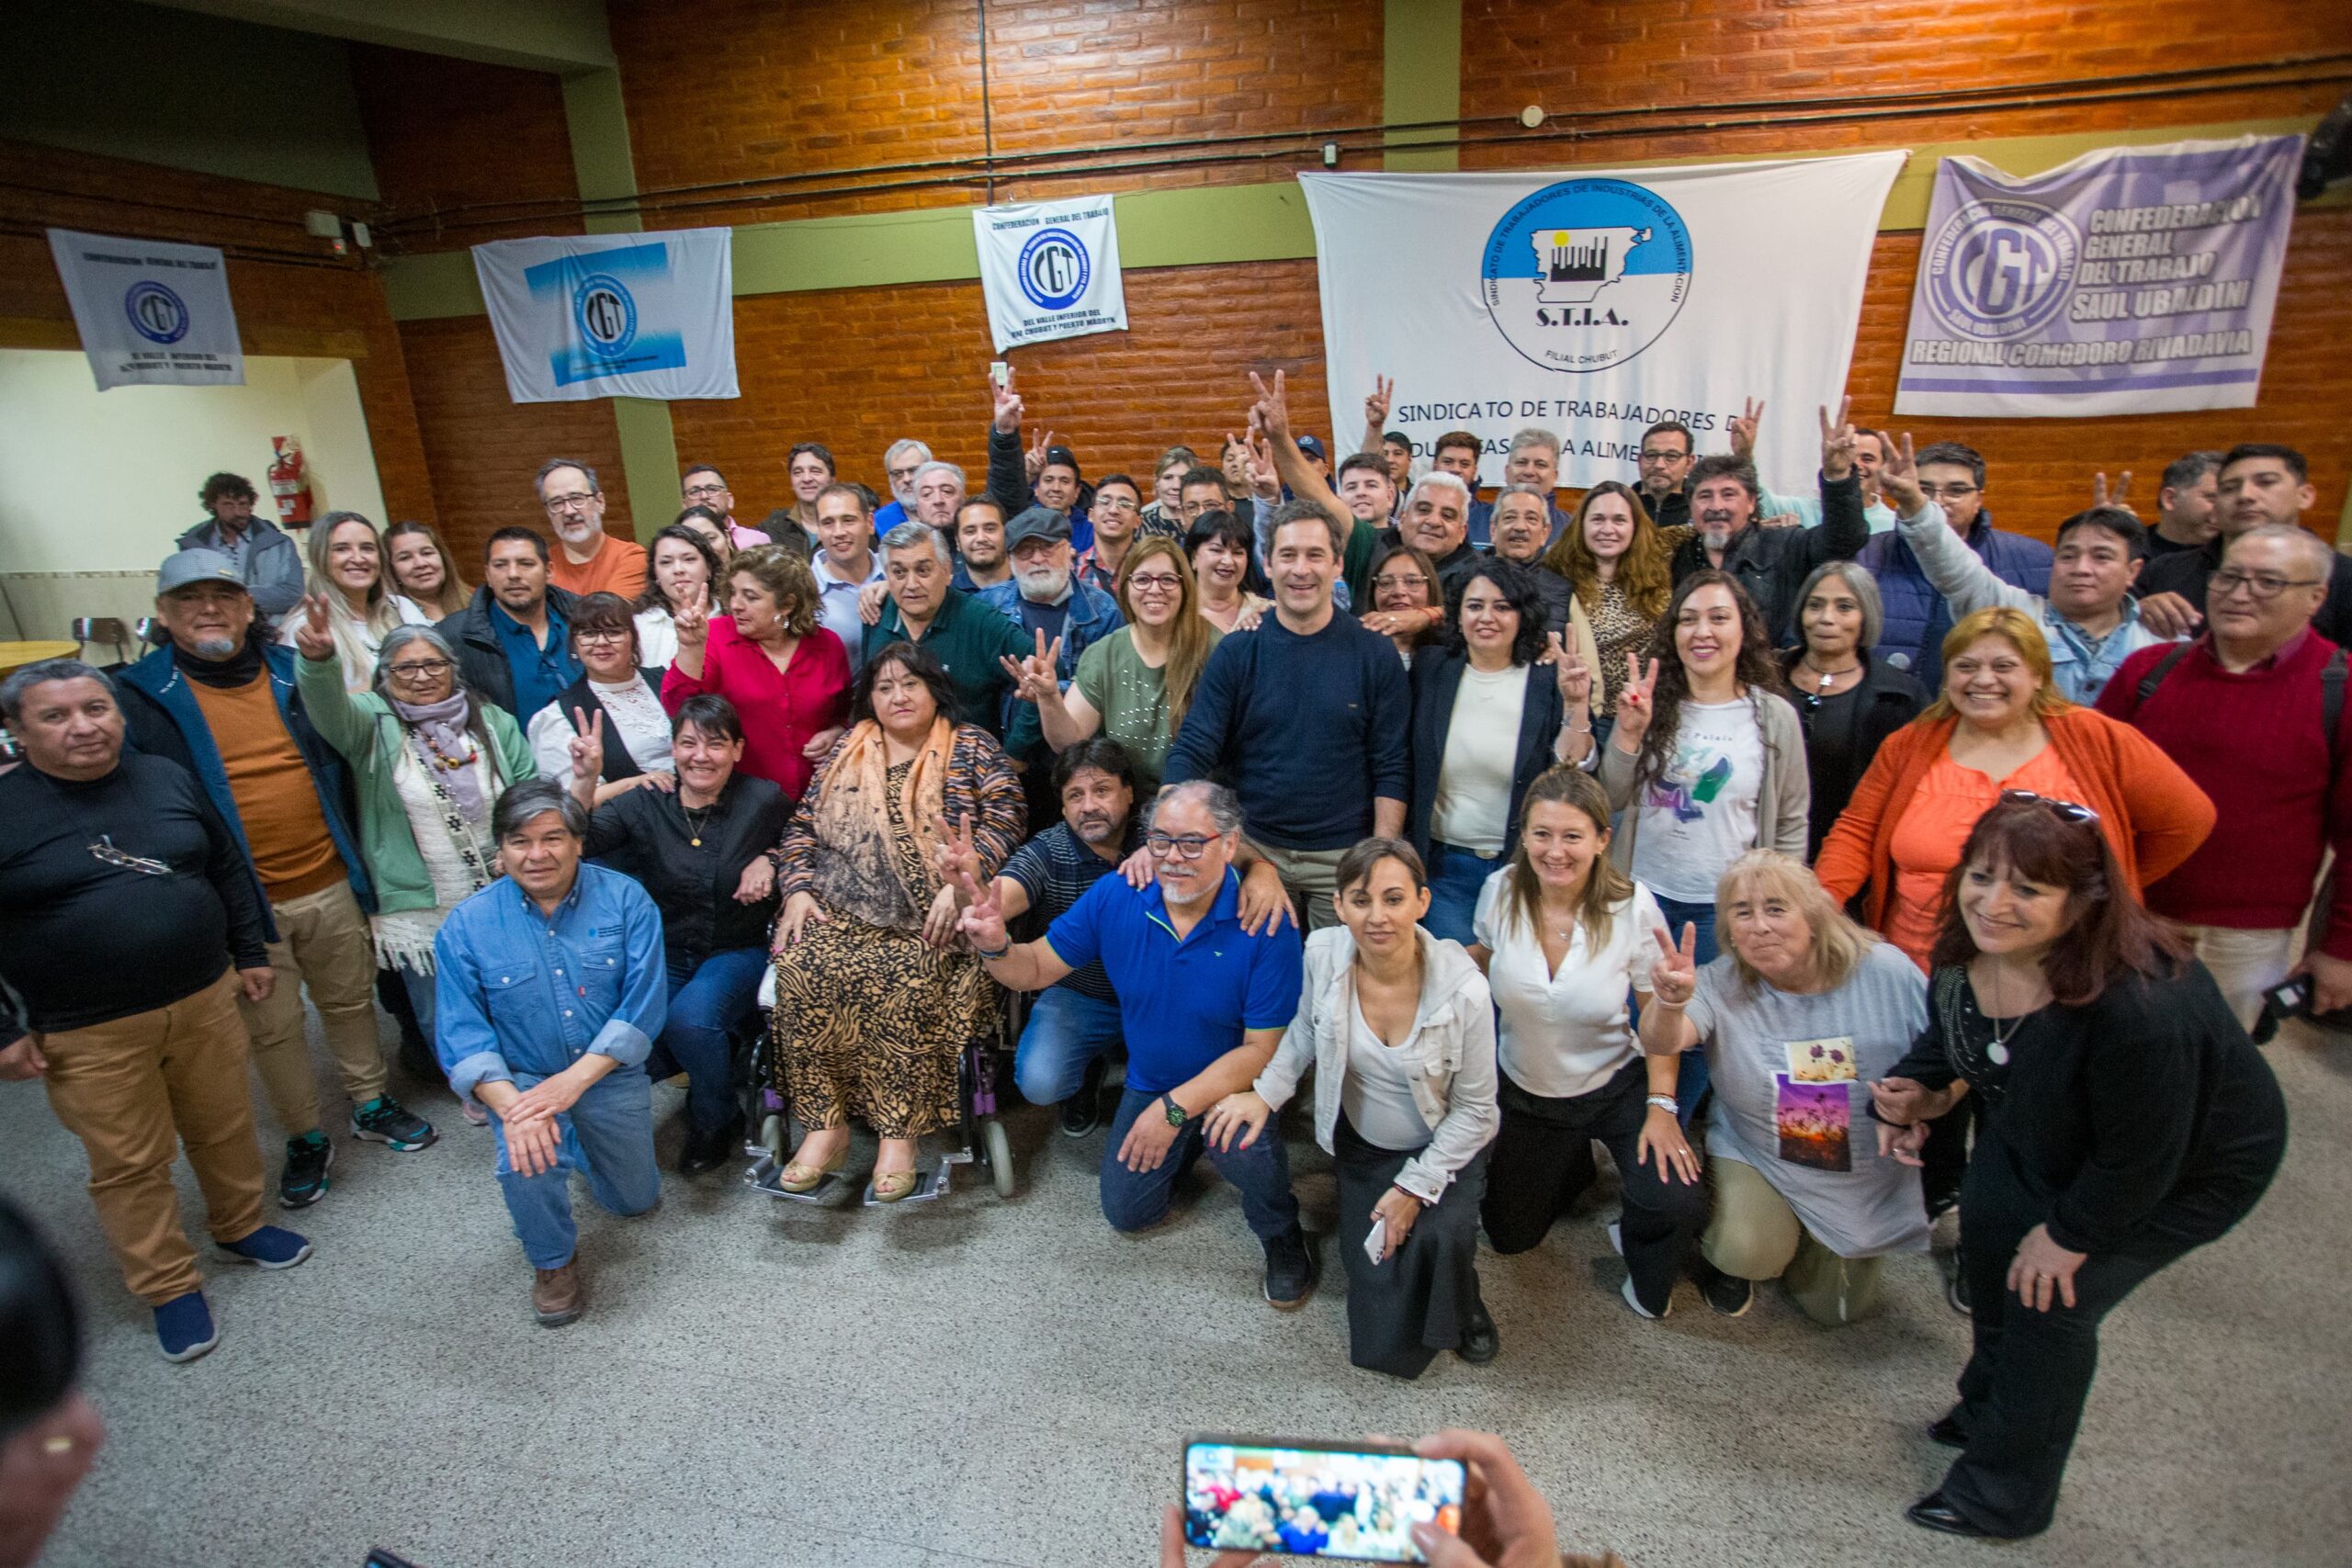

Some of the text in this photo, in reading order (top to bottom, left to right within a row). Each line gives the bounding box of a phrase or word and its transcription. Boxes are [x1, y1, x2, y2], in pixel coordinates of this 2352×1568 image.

[1489, 185, 1687, 307] SINDICATO DE TRABAJADORES DE INDUSTRIAS DE LA ALIMENTACION
[2085, 231, 2173, 259] GENERAL
[2077, 251, 2216, 286] DEL TRABAJO
[2071, 278, 2250, 321] SAUL UBALDINI
[1535, 307, 1629, 327] S.T.I.A.
[1544, 349, 1618, 364] FILIAL CHUBUT
[1910, 330, 2252, 367] REGIONAL COMODORO RIVADAVIA
[1398, 401, 1513, 423] SINDICATO
[1521, 400, 1548, 418] DE
[1555, 400, 1716, 431] TRABAJADORES
